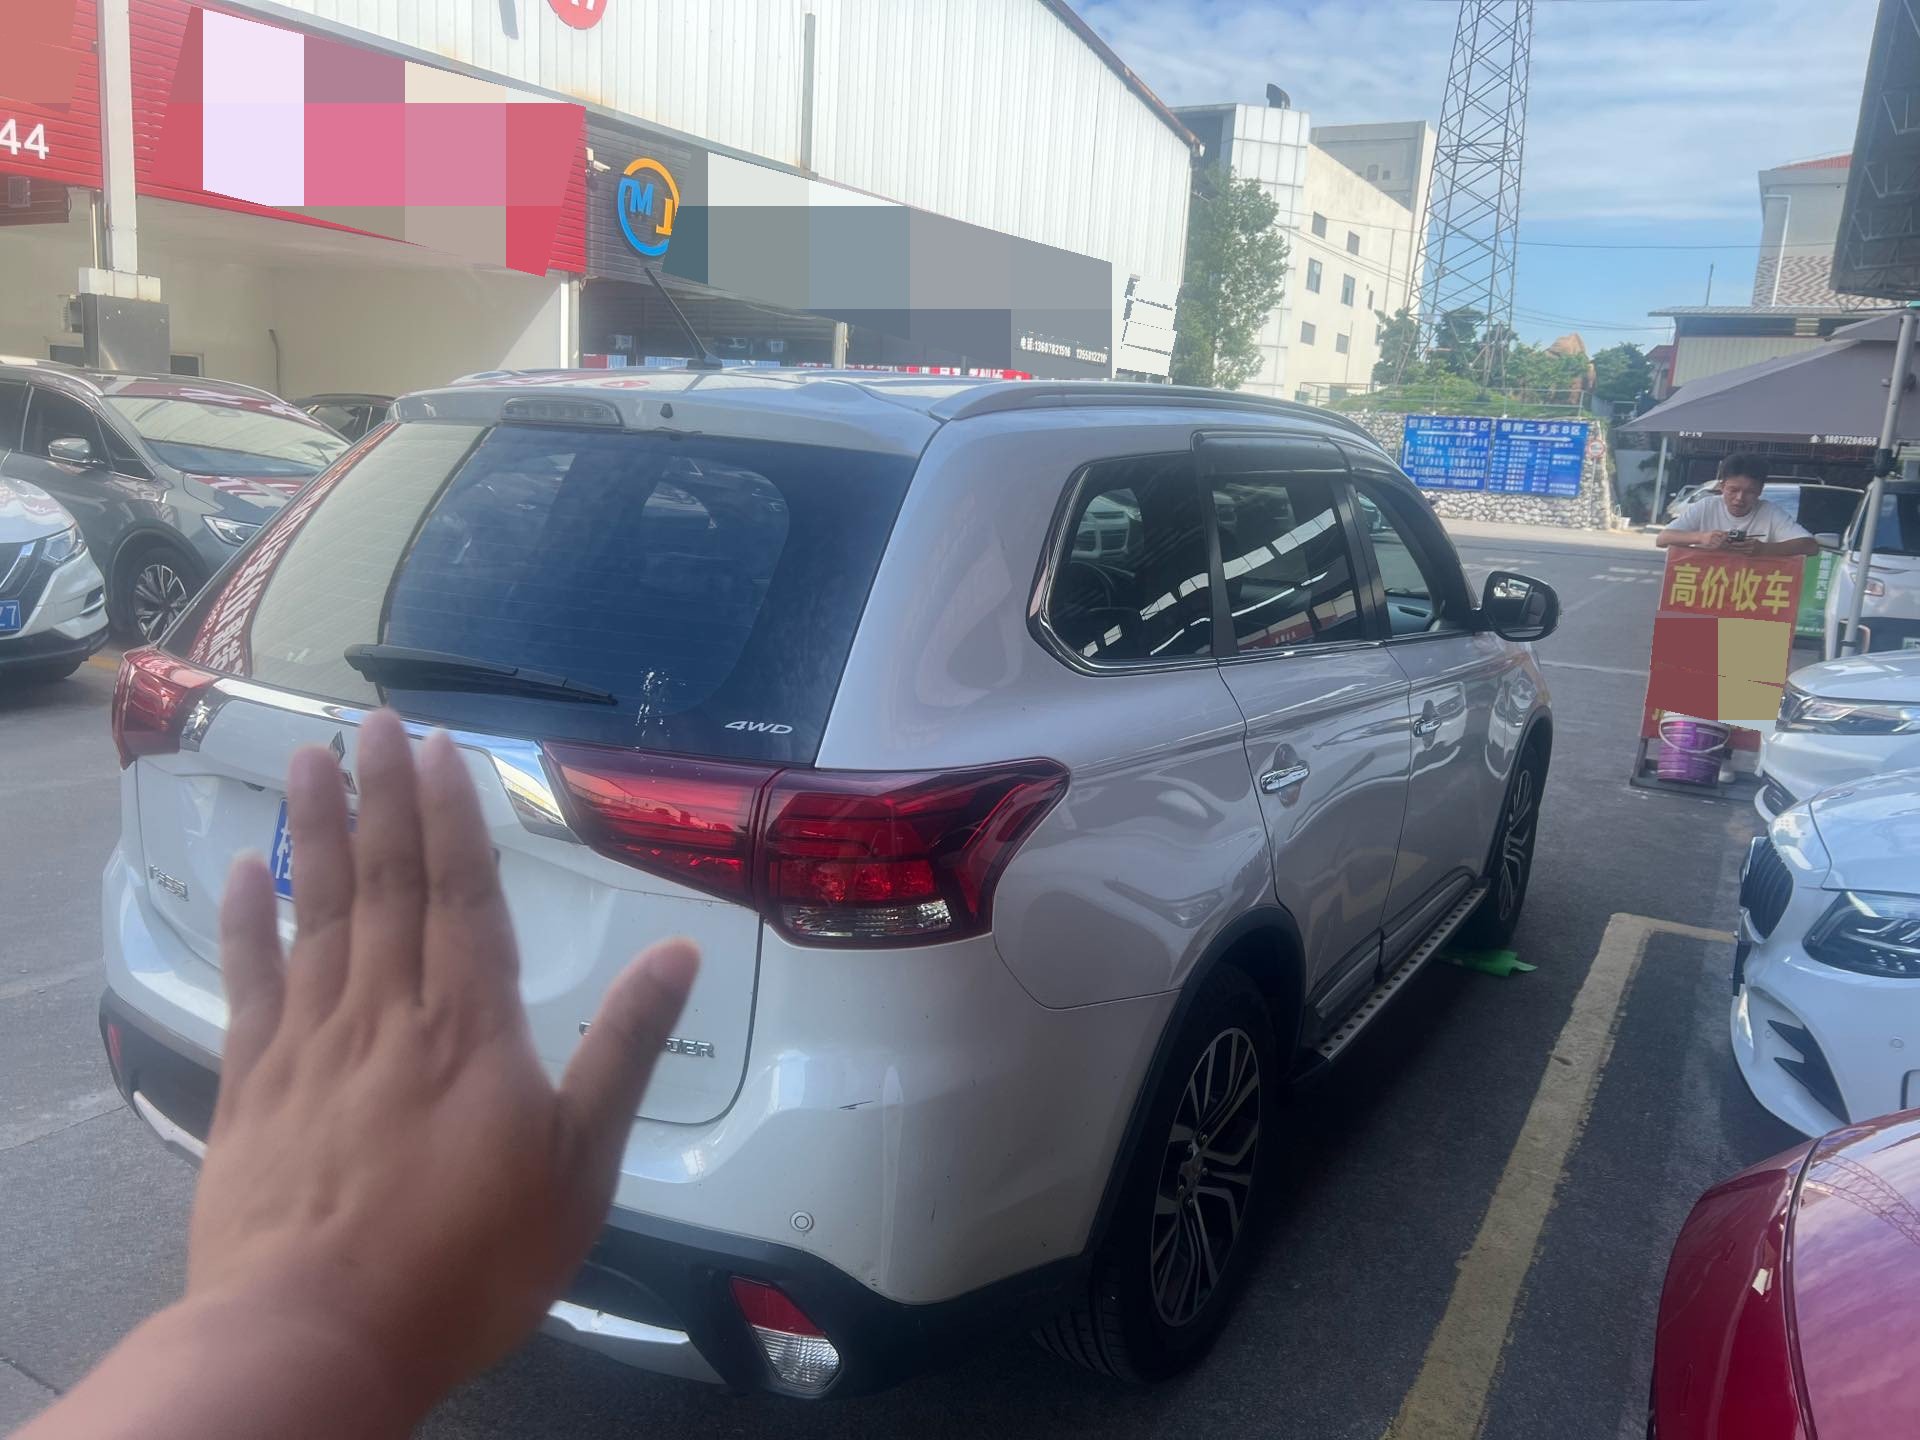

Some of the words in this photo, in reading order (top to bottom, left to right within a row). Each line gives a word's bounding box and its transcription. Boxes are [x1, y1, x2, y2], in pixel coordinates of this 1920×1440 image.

[1669, 563, 1793, 615] 高价收车
[724, 720, 793, 734] 4WD
